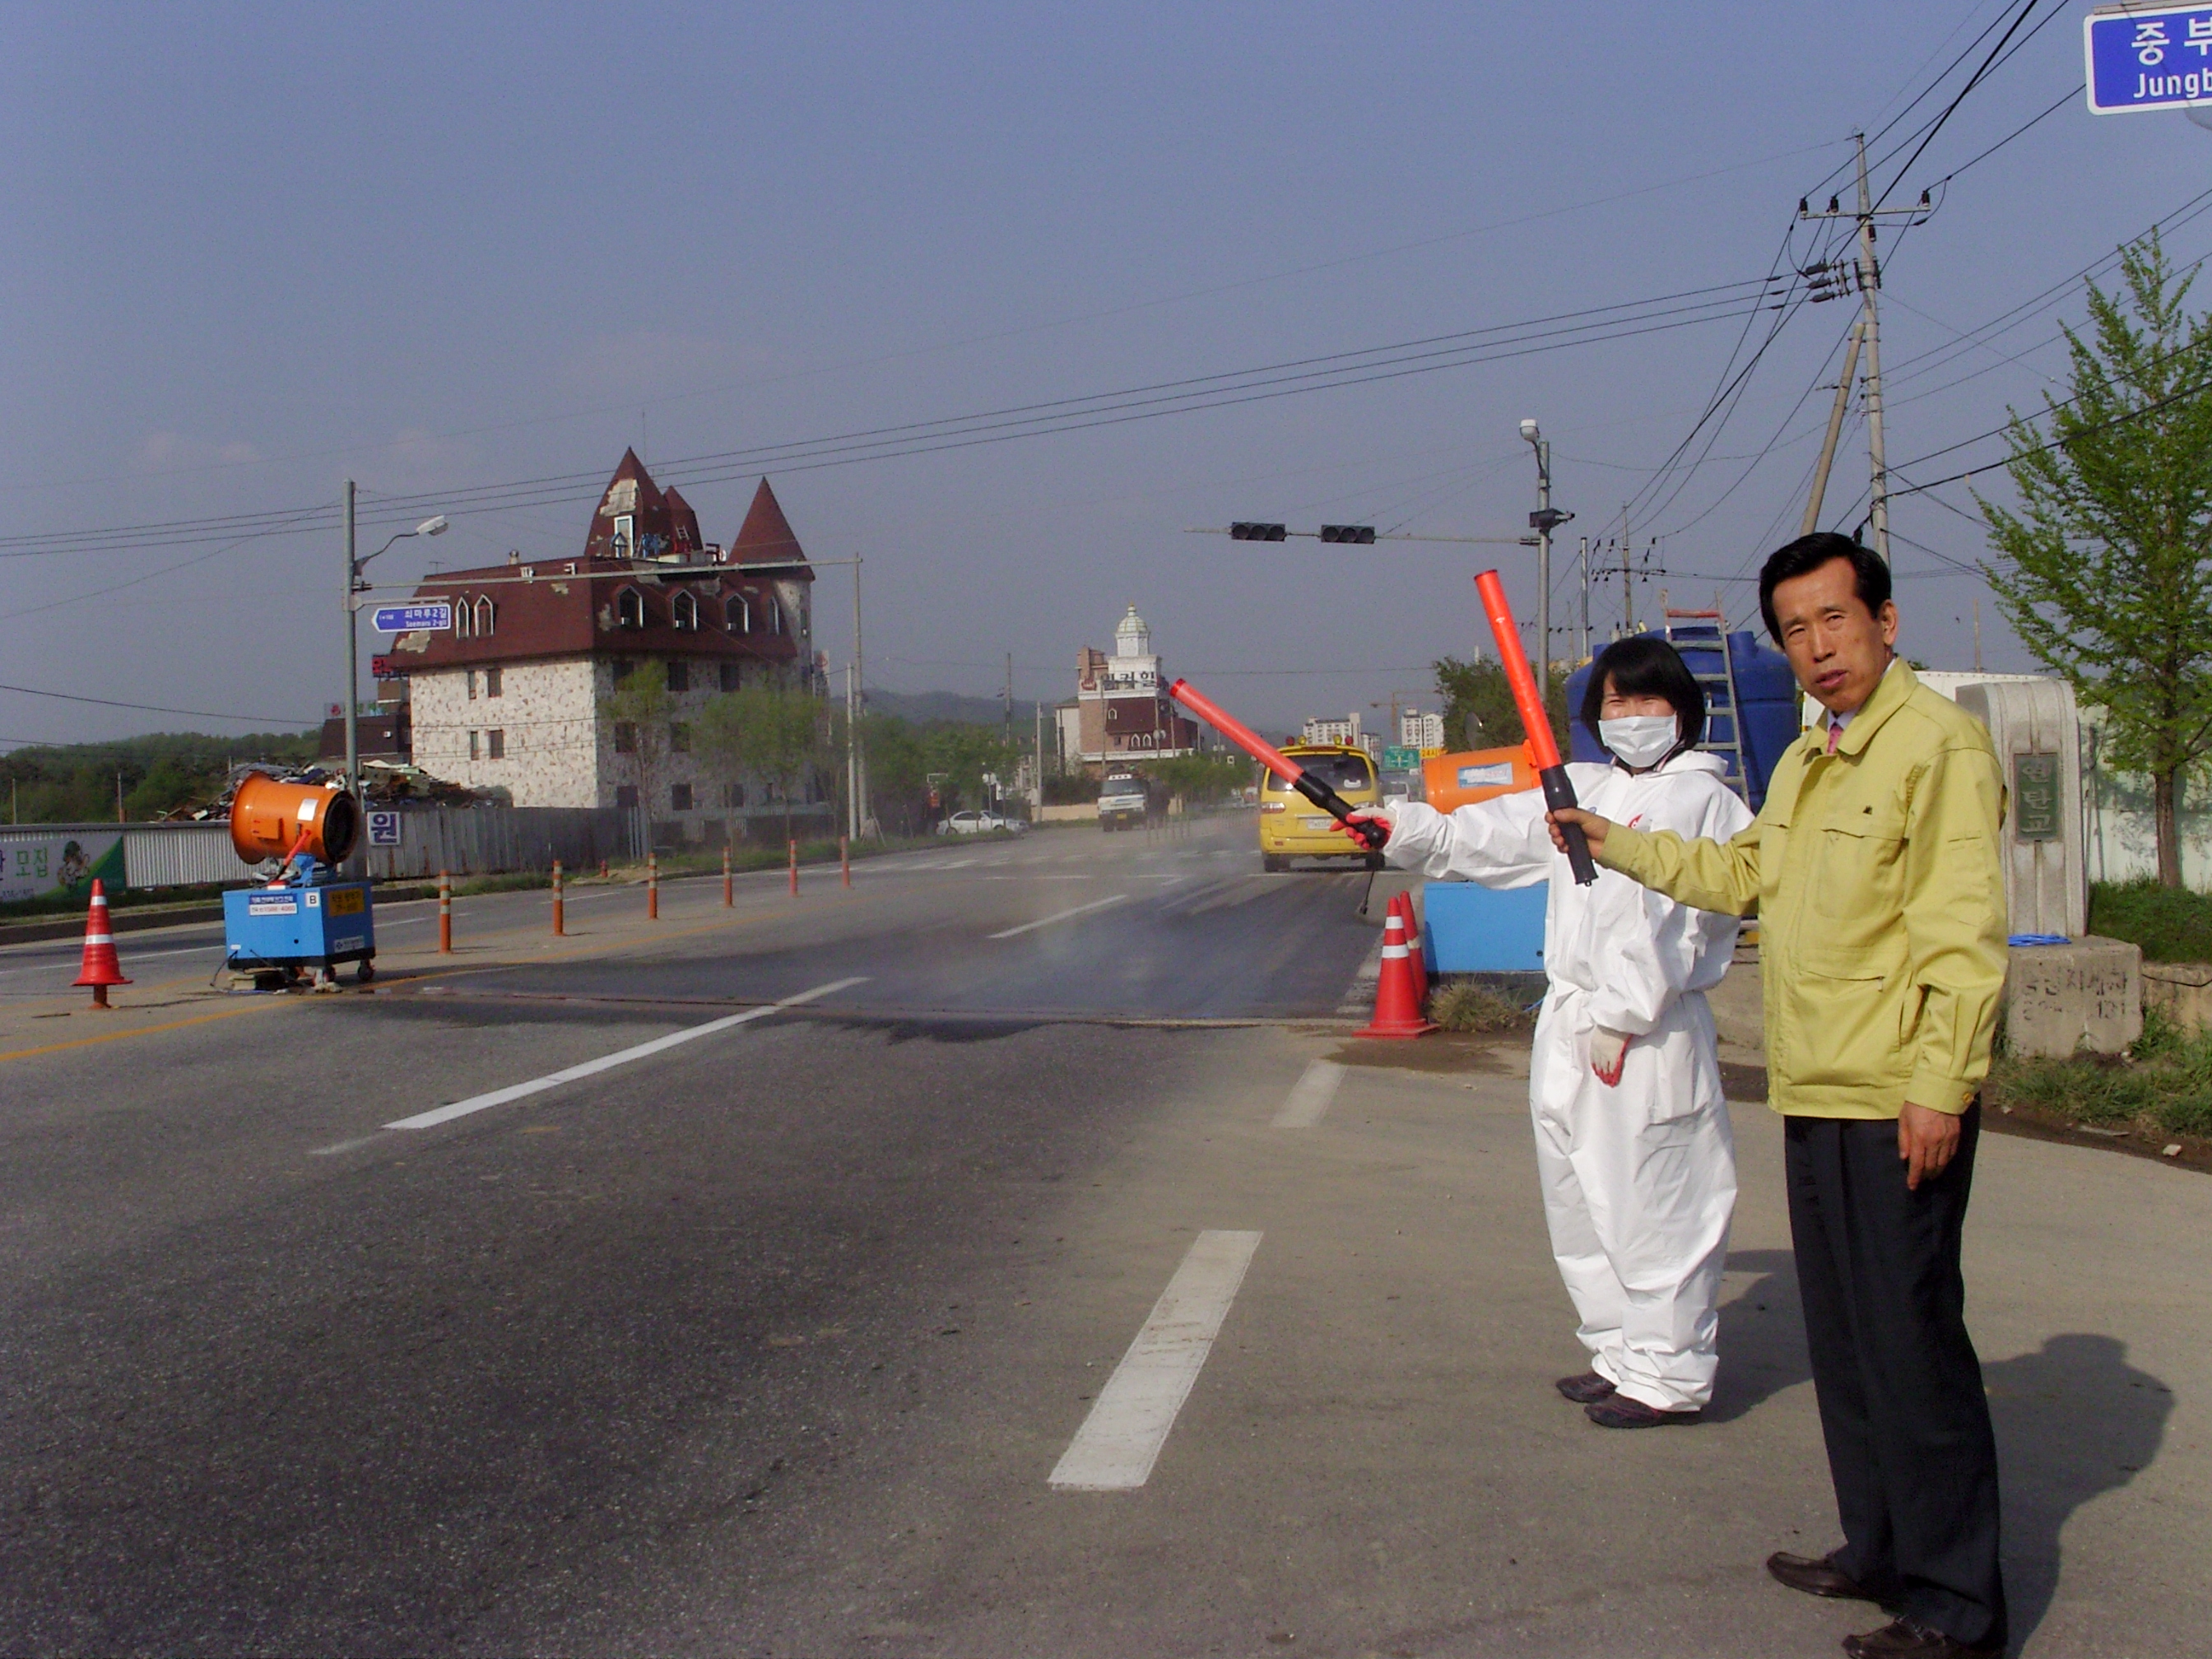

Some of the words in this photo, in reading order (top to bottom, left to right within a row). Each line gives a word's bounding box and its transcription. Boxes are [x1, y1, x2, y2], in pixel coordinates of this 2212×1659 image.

[2131, 18, 2212, 66] 중부
[2133, 67, 2212, 99] Jungb
[16, 847, 48, 877] 모집
[309, 895, 317, 904] B
